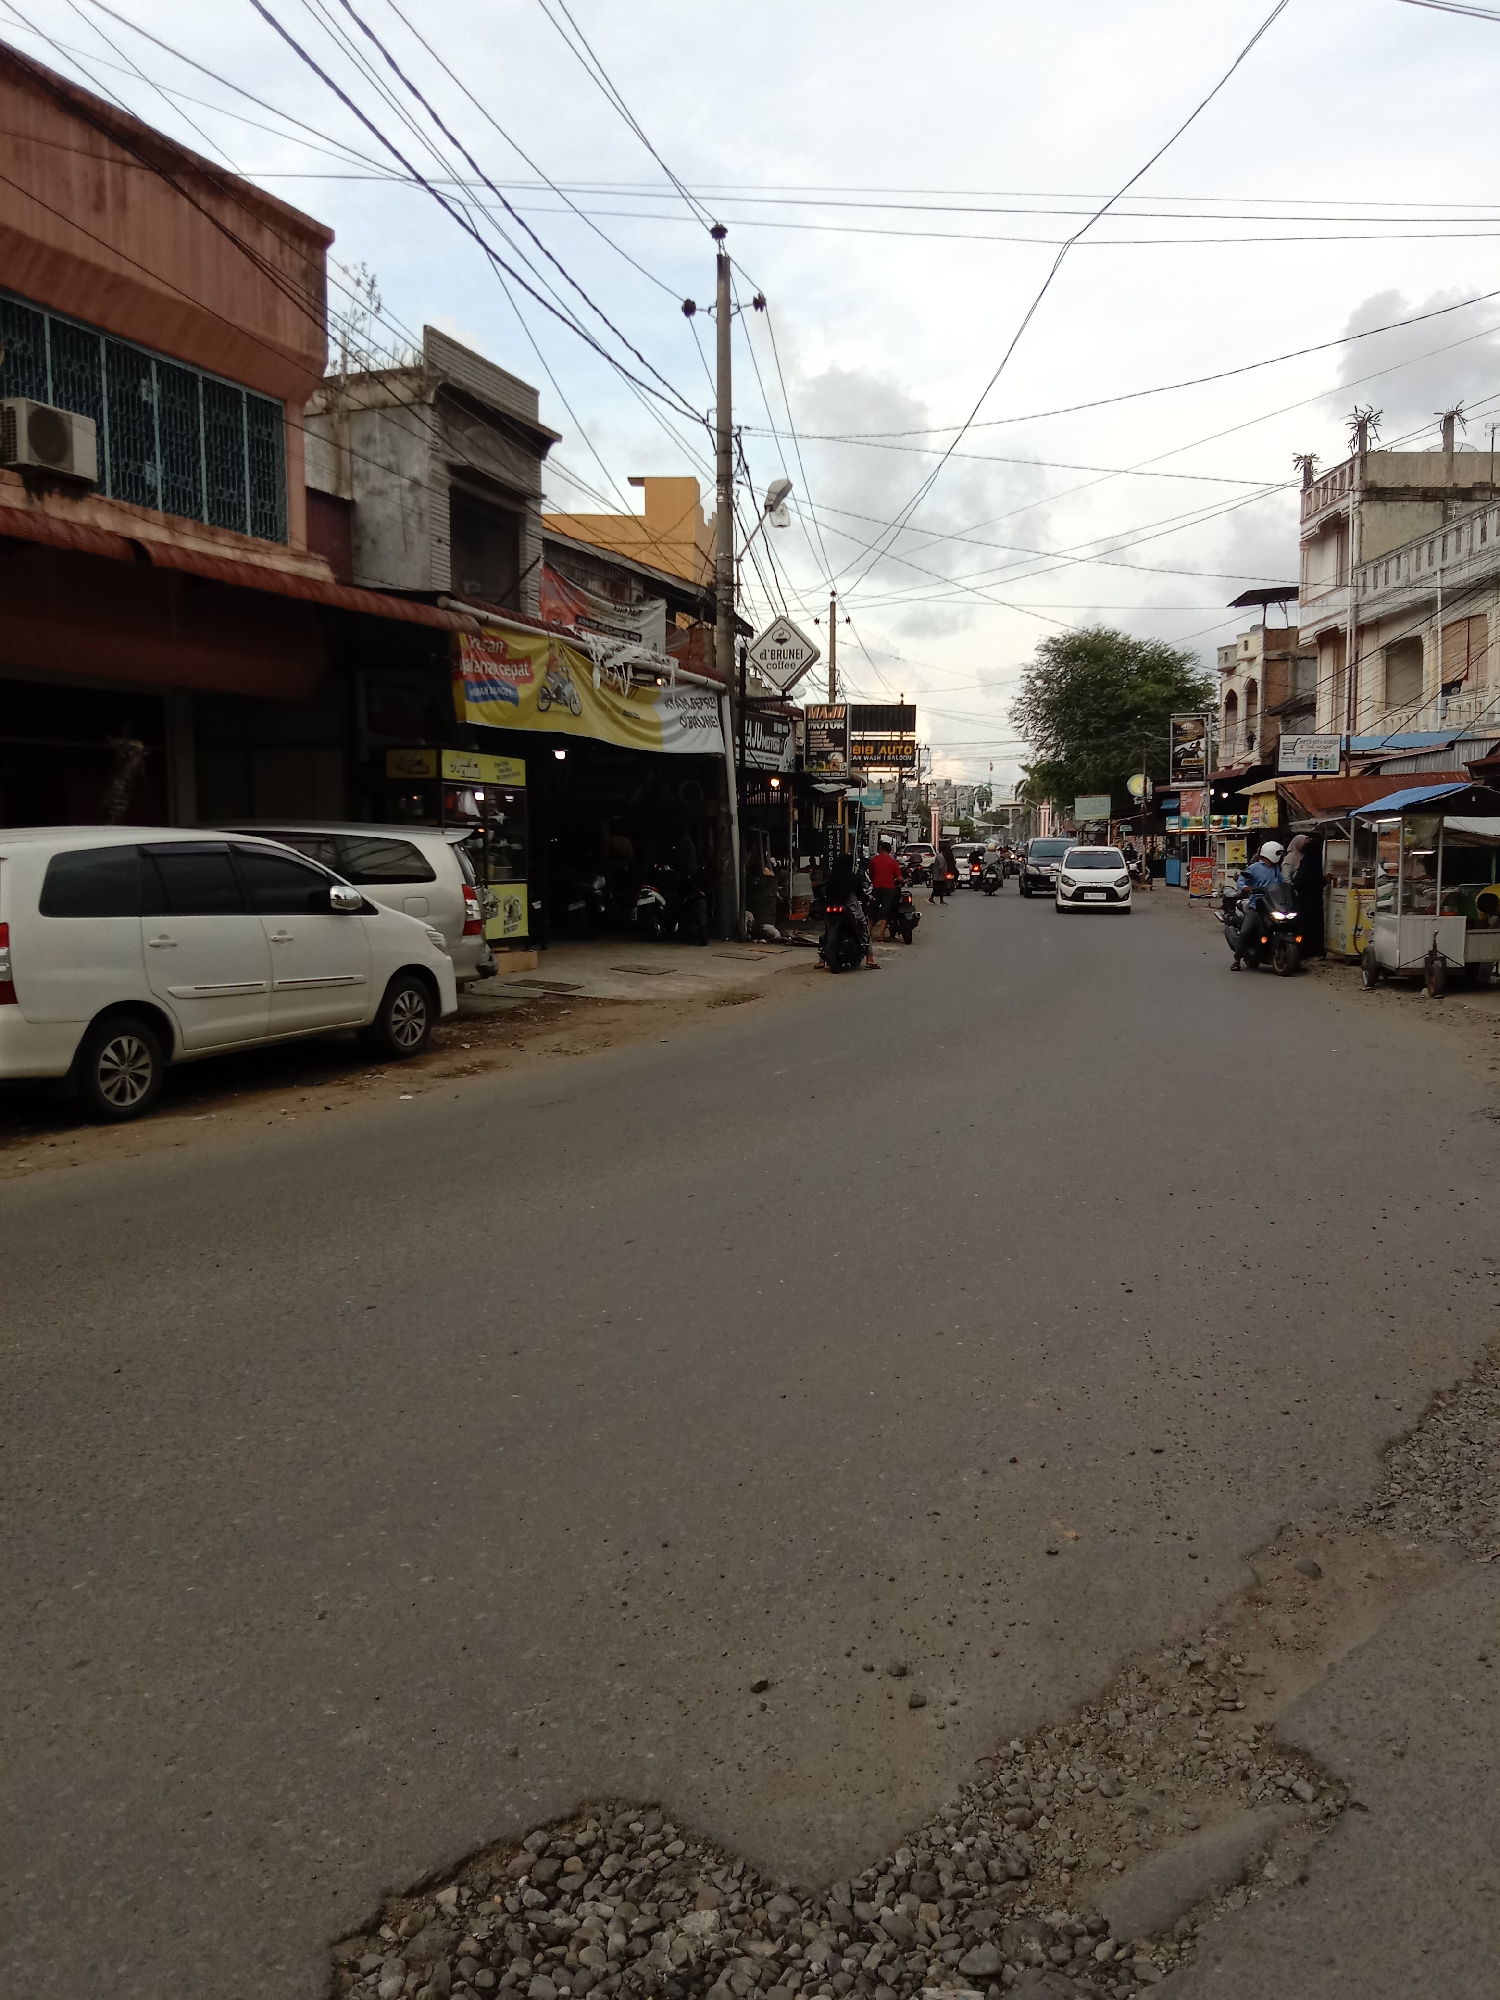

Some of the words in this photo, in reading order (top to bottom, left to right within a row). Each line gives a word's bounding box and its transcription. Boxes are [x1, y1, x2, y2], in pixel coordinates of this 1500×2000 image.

[577, 617, 598, 630] Service
[500, 661, 530, 680] cepat
[766, 660, 797, 670] coffee
[664, 697, 689, 710] AYAM
[808, 705, 846, 719] MAJU
[807, 720, 845, 730] MOTOR
[878, 744, 913, 755] AUTO
